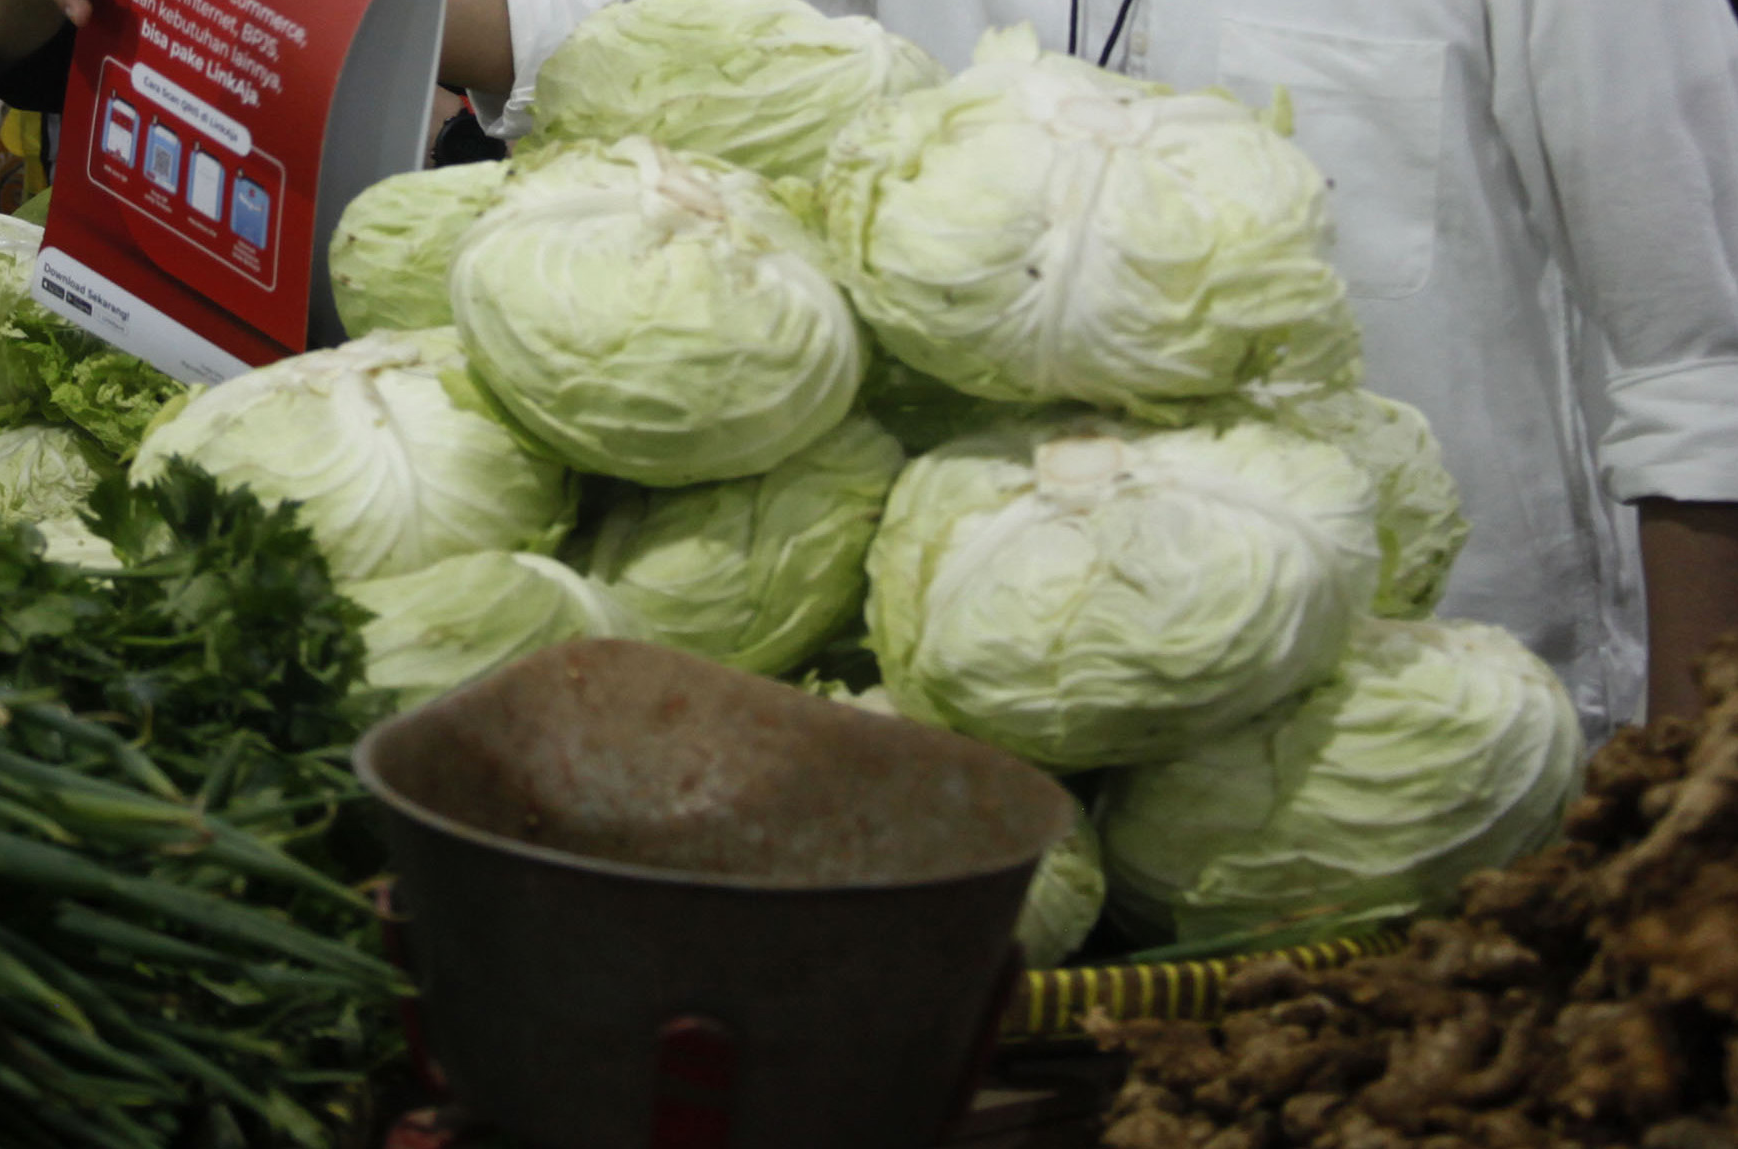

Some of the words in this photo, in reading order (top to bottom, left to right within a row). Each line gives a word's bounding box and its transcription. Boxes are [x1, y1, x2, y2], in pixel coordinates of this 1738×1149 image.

[140, 17, 169, 50] bisa
[169, 39, 205, 72] pake
[158, 0, 229, 59] kebutuhan
[230, 45, 283, 96] lainnya,
[43, 262, 86, 296] Download
[86, 287, 131, 323] Sekarang!
